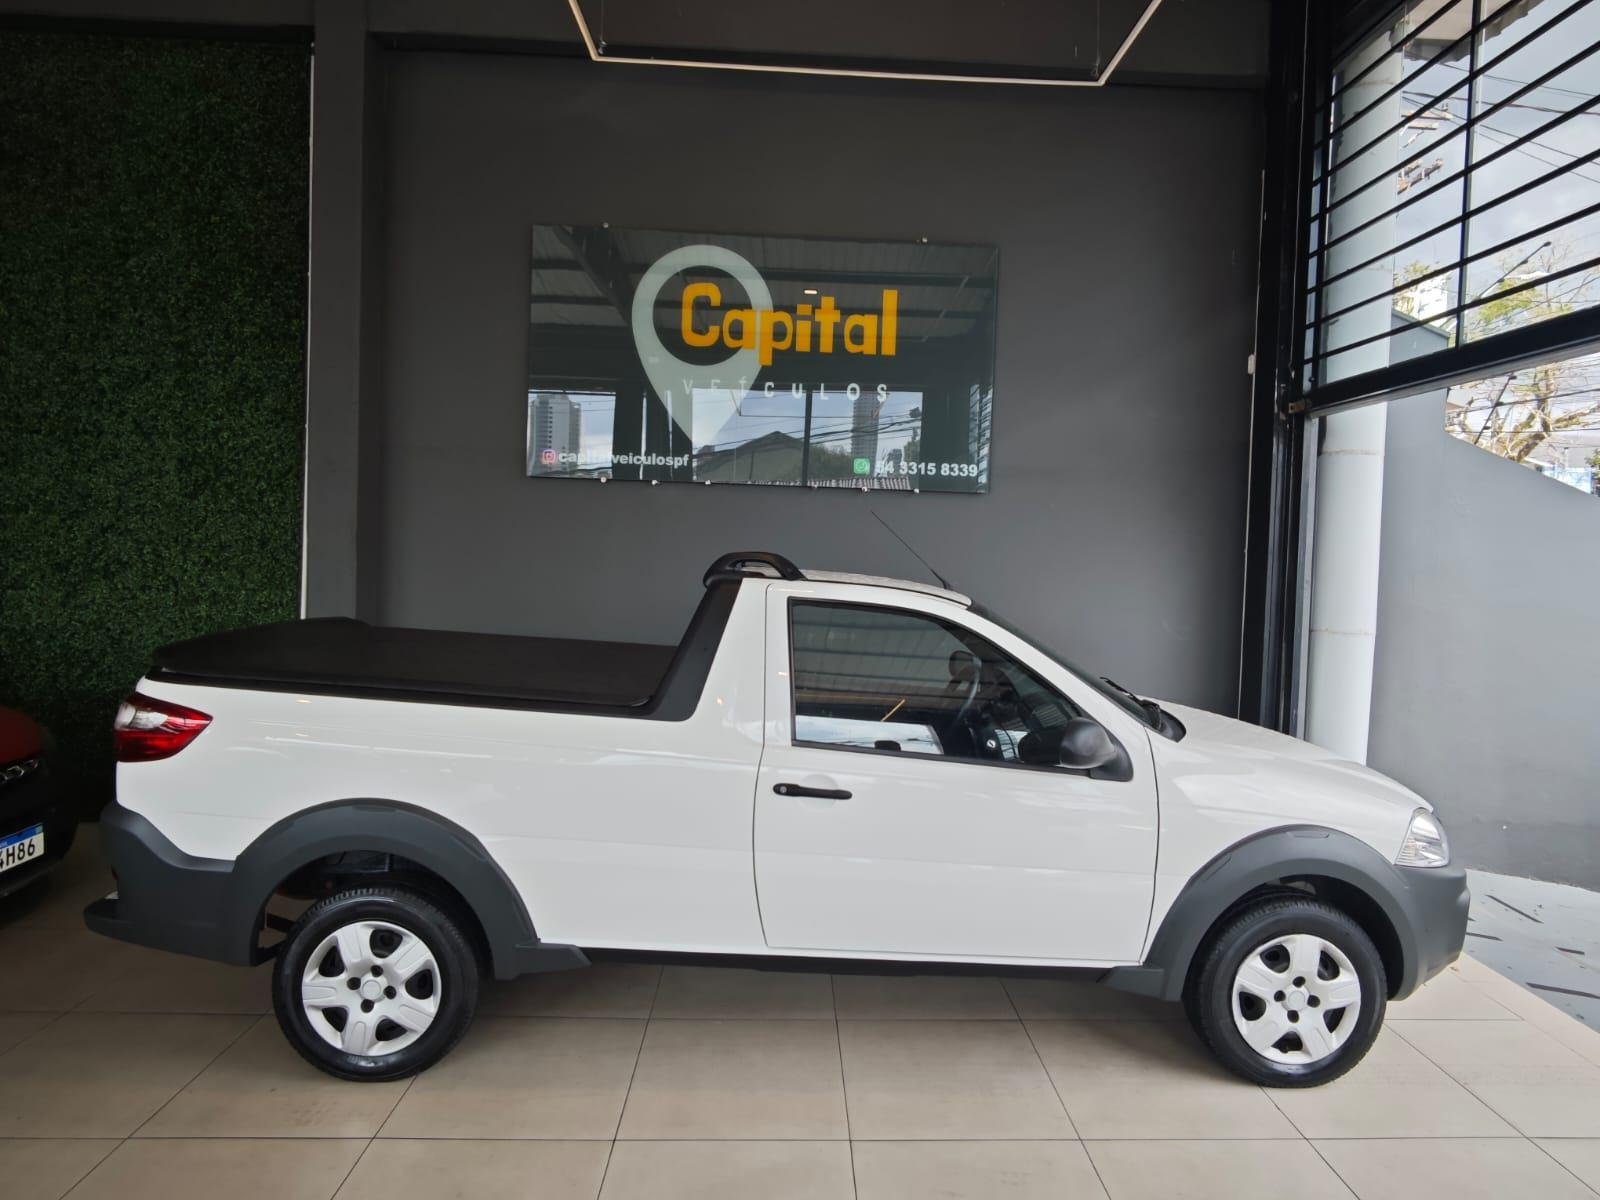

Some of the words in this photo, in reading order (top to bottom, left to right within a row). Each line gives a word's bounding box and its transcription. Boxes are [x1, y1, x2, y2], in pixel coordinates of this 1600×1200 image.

[682, 282, 898, 366] Capital
[683, 376, 888, 402] VEÍCULOS
[558, 451, 690, 469] capveiculospf
[899, 461, 937, 476] 3315
[940, 462, 978, 478] 8339
